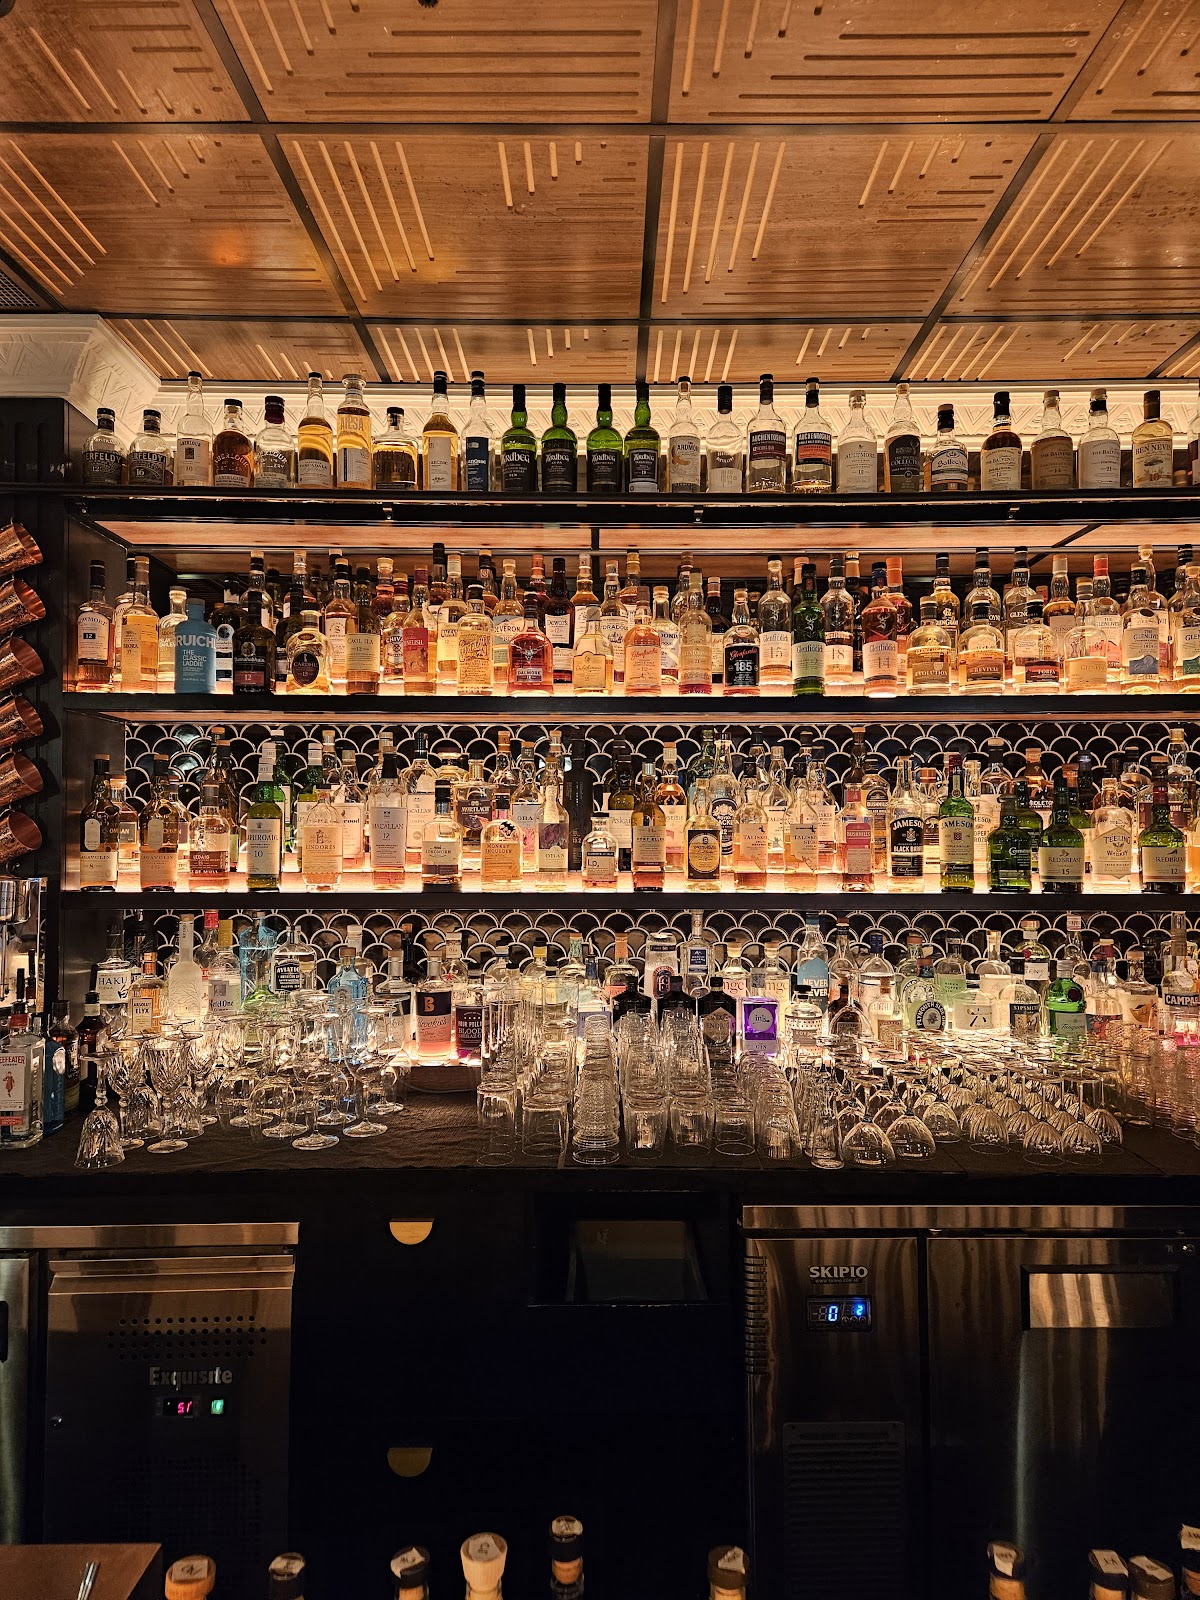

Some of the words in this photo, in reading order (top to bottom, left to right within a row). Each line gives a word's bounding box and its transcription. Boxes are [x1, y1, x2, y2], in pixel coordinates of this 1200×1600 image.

[1135, 446, 1151, 455] BEN
[183, 655, 207, 663] CLASSIC
[770, 647, 783, 659] 15
[831, 648, 845, 660] 18
[734, 662, 753, 672] 185
[878, 656, 890, 669] 14
[98, 976, 128, 985] HAKU
[803, 978, 828, 987] NEVER
[424, 997, 435, 1012] B
[809, 1265, 869, 1279] SKIPIO
[149, 1366, 233, 1391] Exquisite
